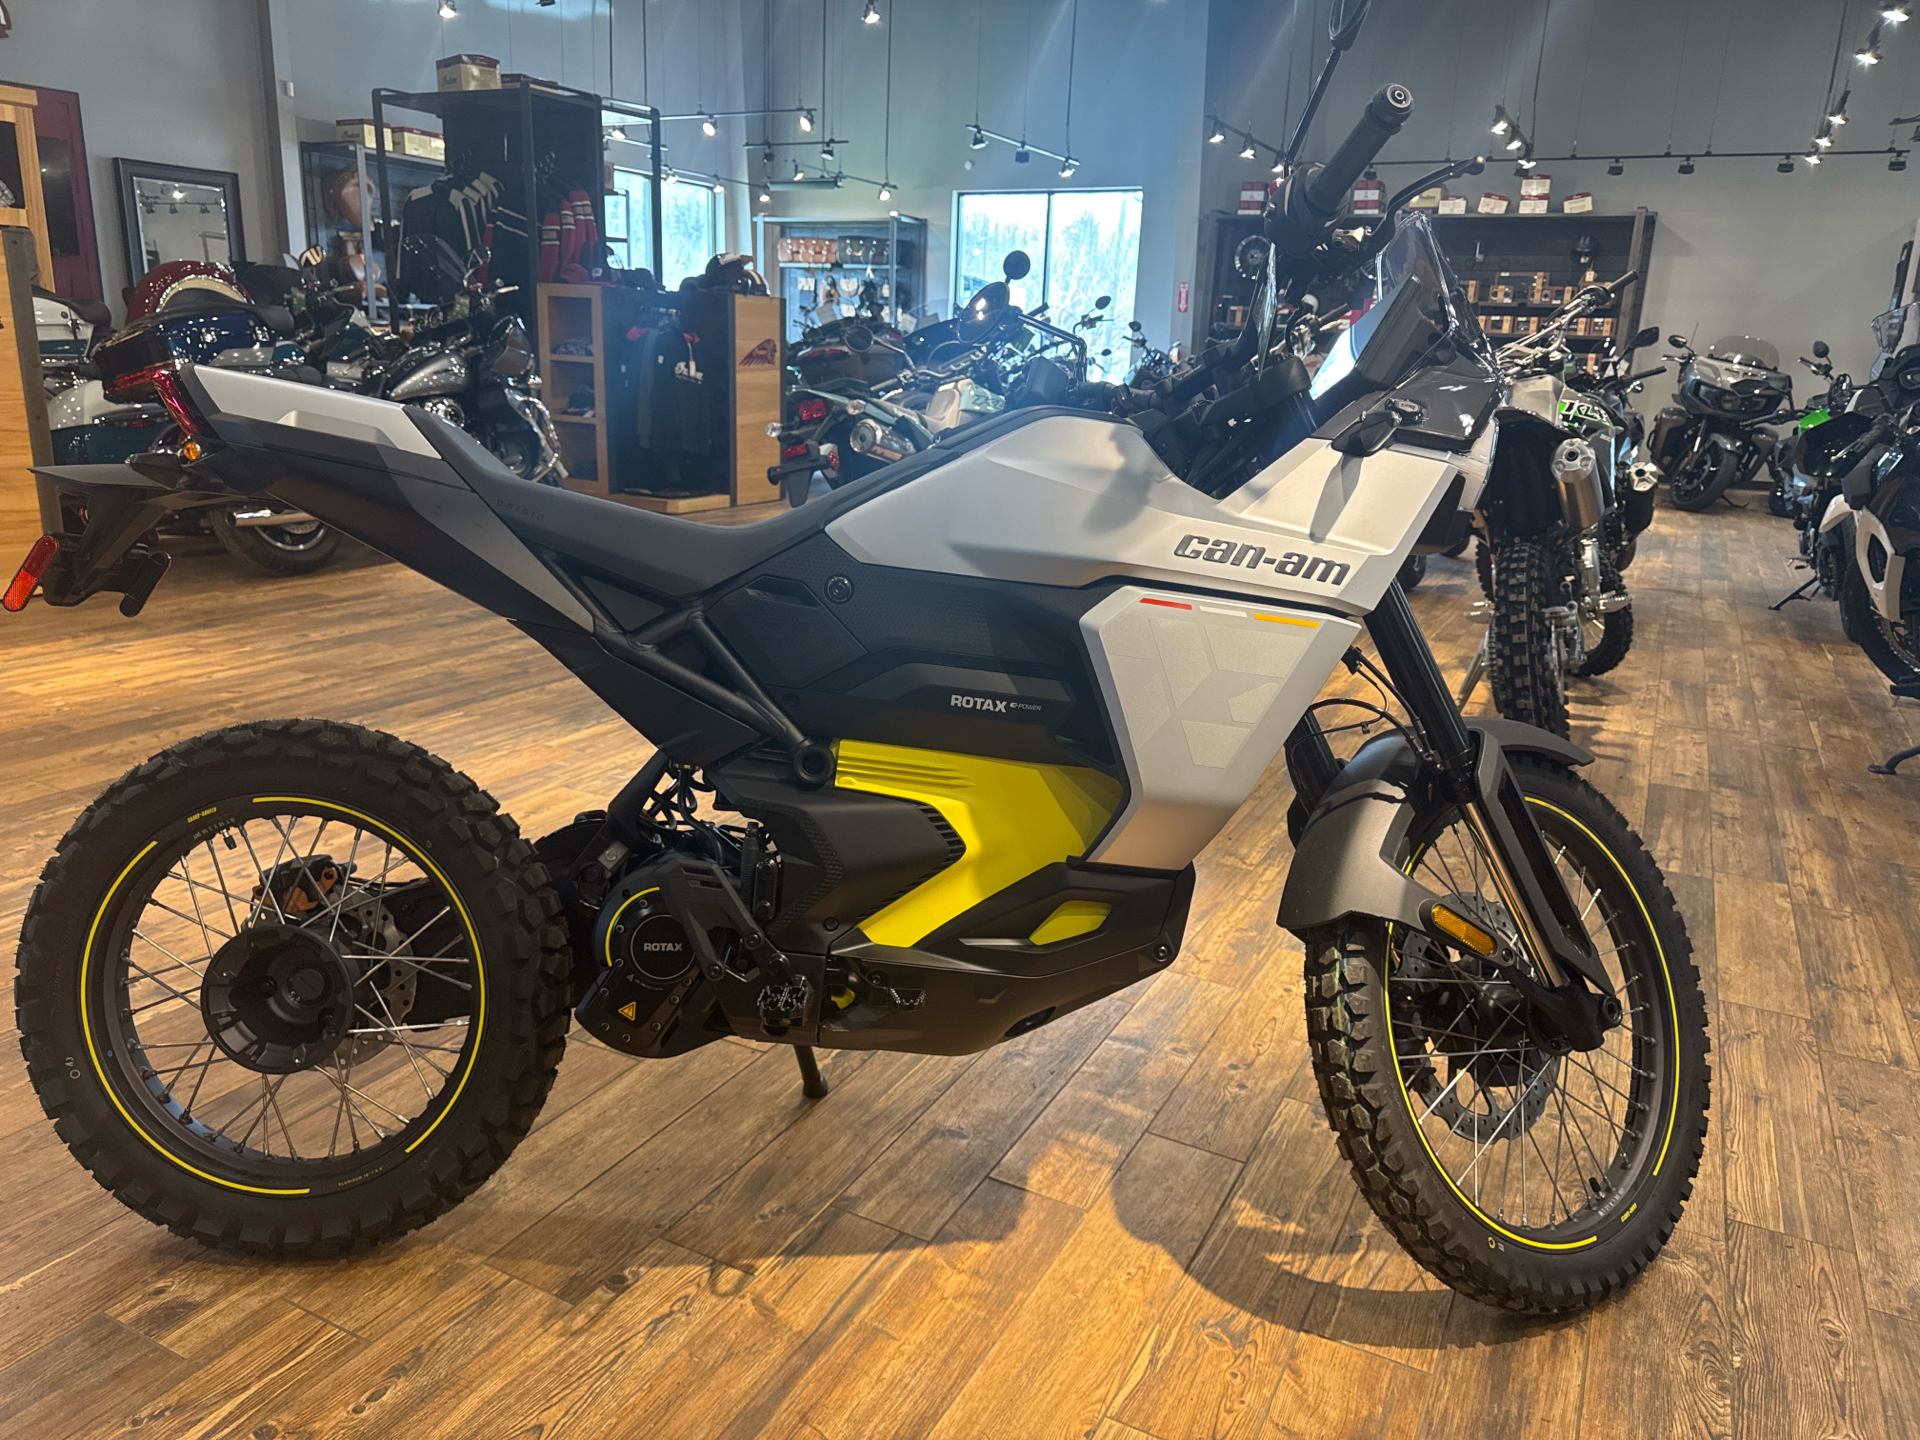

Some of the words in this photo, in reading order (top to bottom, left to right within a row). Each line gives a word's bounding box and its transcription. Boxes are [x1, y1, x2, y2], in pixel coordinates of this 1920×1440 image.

[1174, 534, 1351, 586] can-am
[950, 694, 1007, 713] ROTAX
[643, 942, 683, 952] ROTAX
